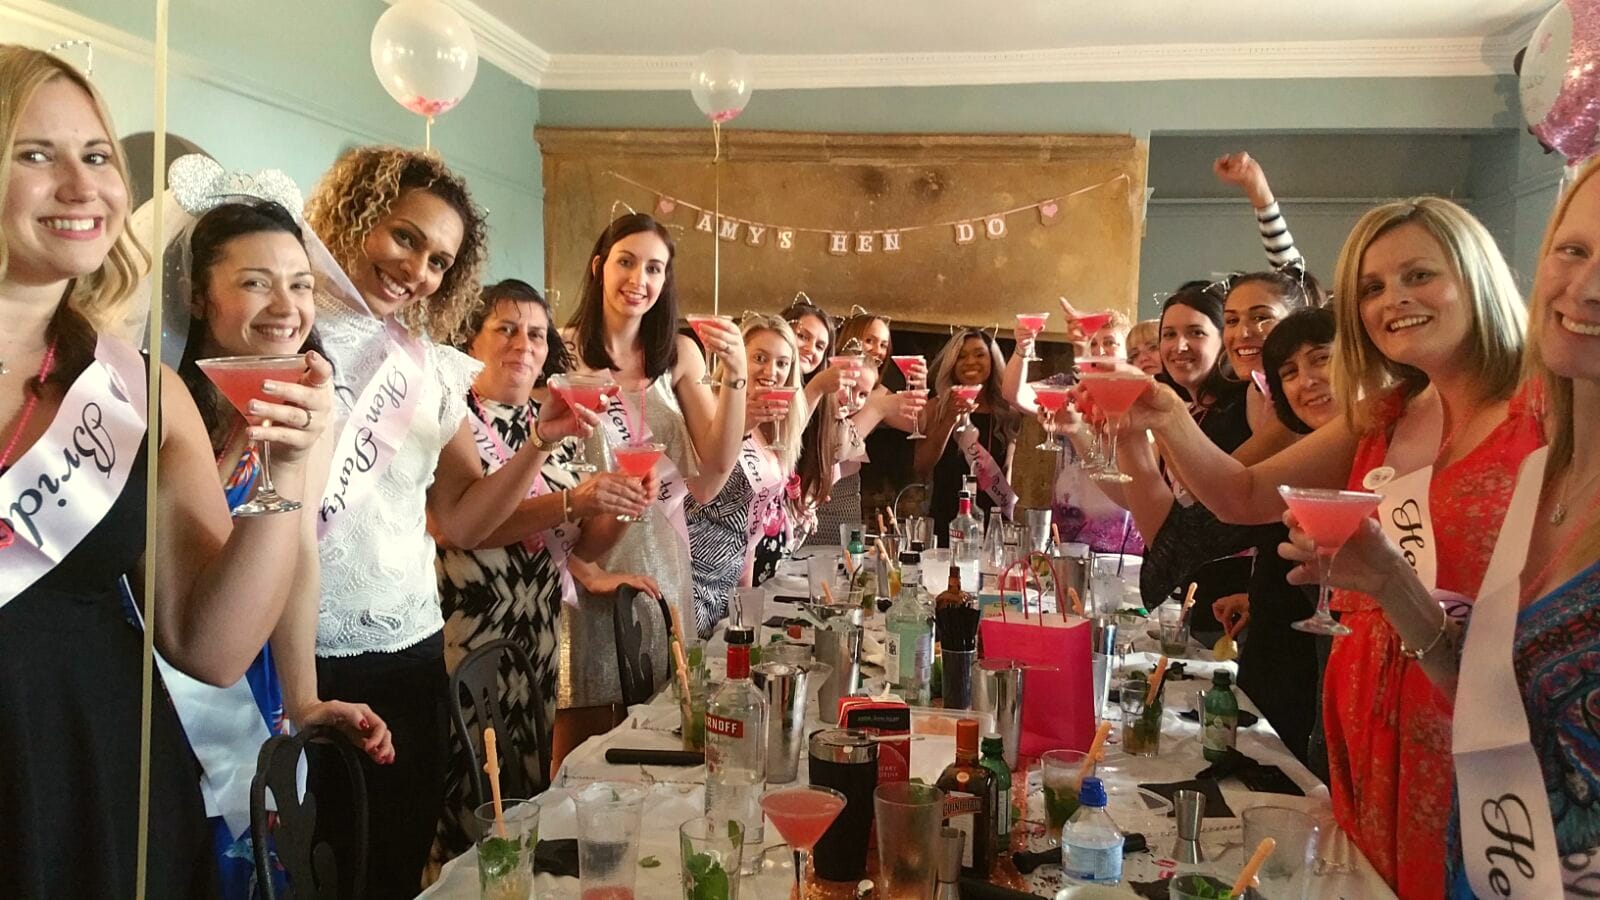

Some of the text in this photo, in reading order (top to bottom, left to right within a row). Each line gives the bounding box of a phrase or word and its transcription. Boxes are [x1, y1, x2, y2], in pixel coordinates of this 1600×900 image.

[696, 213, 1006, 253] AMY'S HEN DO
[319, 365, 408, 522] Hen Party
[607, 395, 632, 441] Hen
[3, 402, 116, 550] Brid
[743, 447, 769, 535] Hen Party
[1391, 498, 1424, 576] He
[1481, 793, 1535, 900] He
